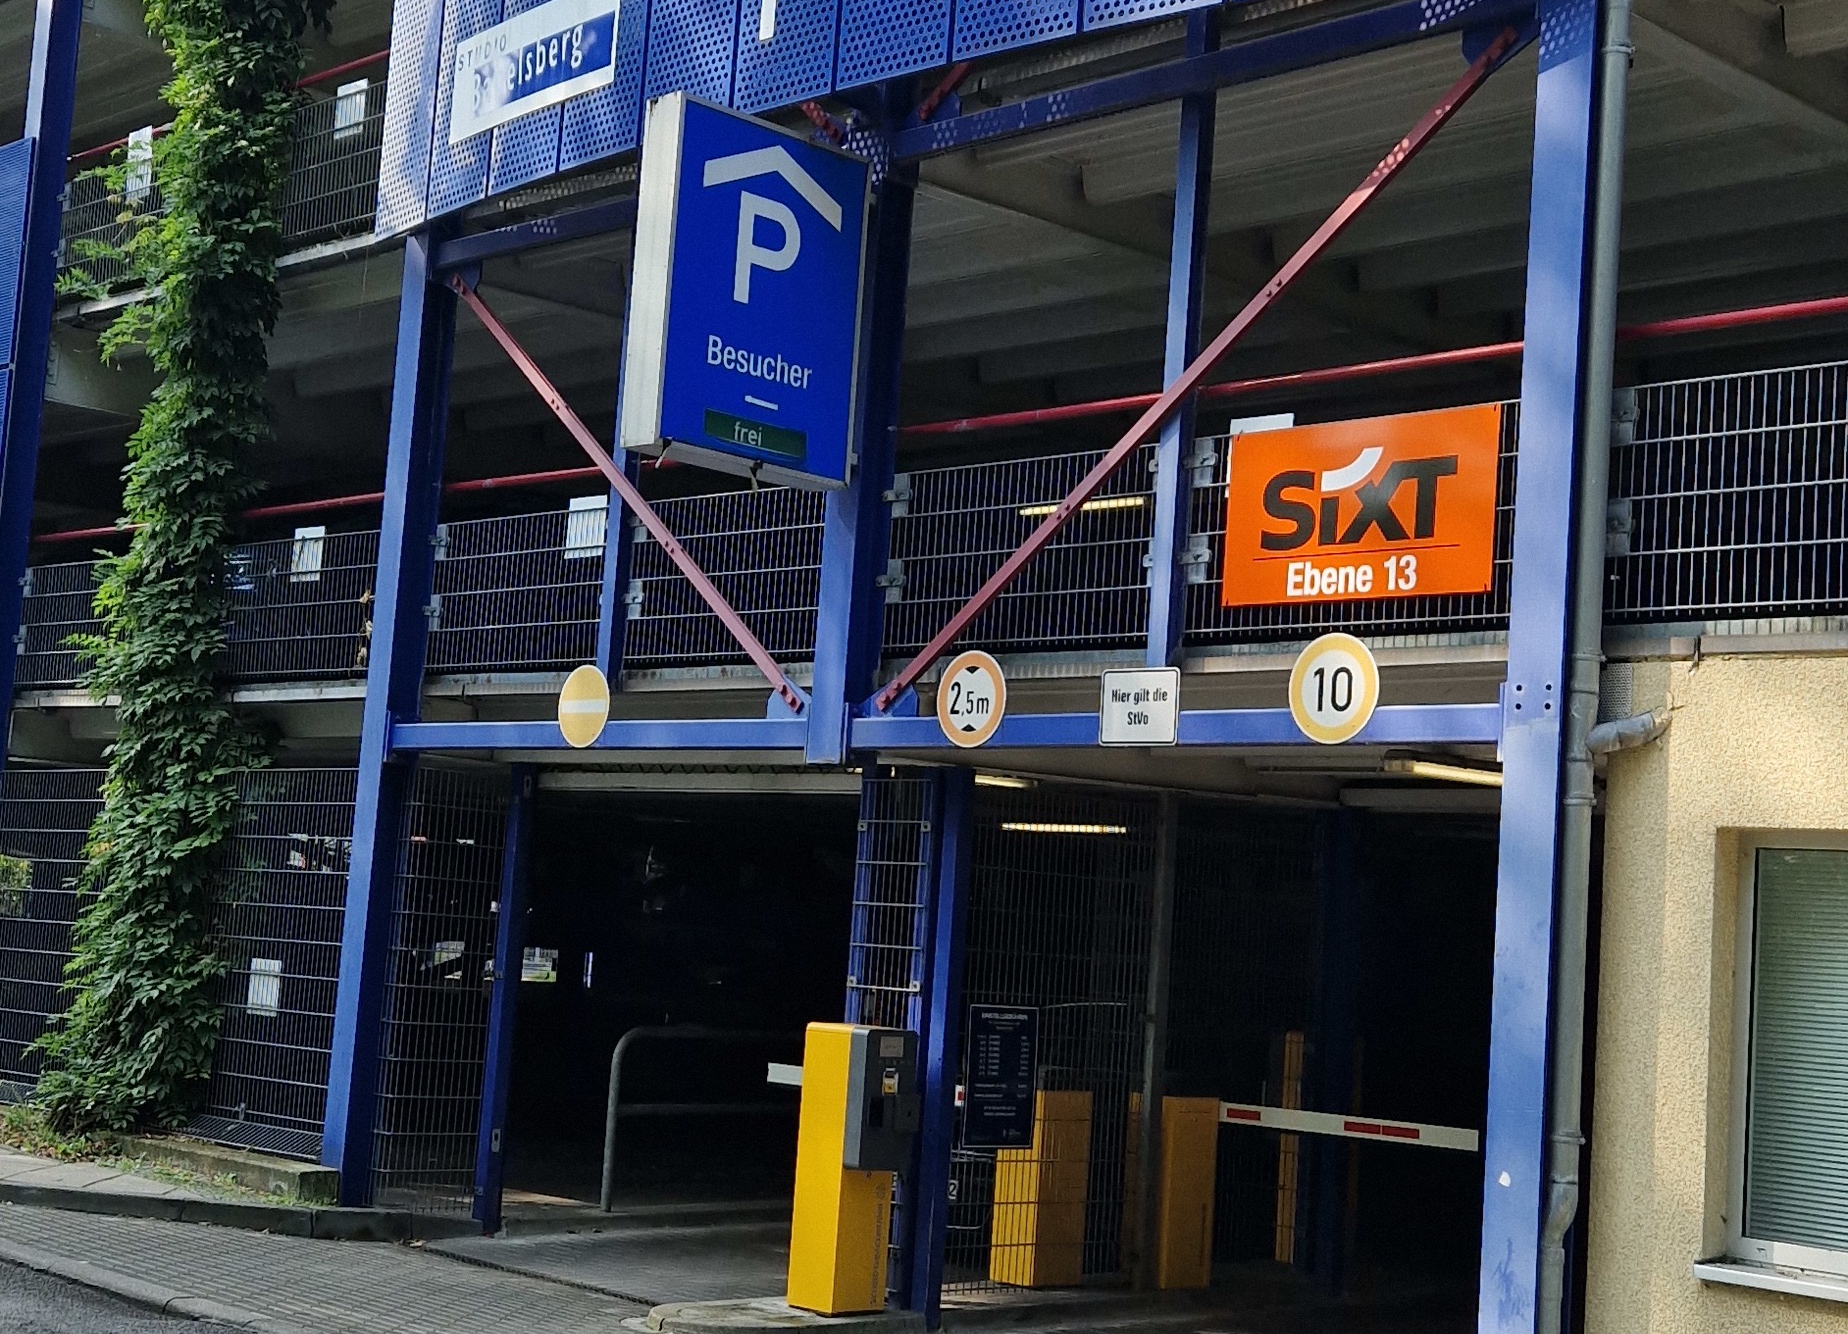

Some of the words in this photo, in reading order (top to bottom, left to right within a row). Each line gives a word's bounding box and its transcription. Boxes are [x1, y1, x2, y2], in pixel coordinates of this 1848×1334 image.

[473, 23, 584, 110] Belsberg
[733, 190, 801, 304] P
[707, 334, 812, 389] Besucher
[734, 421, 762, 446] frei
[1286, 561, 1373, 597] Ebene
[1383, 555, 1417, 591] 13
[1111, 689, 1131, 703] Hier
[1133, 688, 1150, 705] gilt
[1152, 687, 1168, 702] die
[1313, 666, 1353, 712] 10
[1127, 710, 1149, 726] StVo
